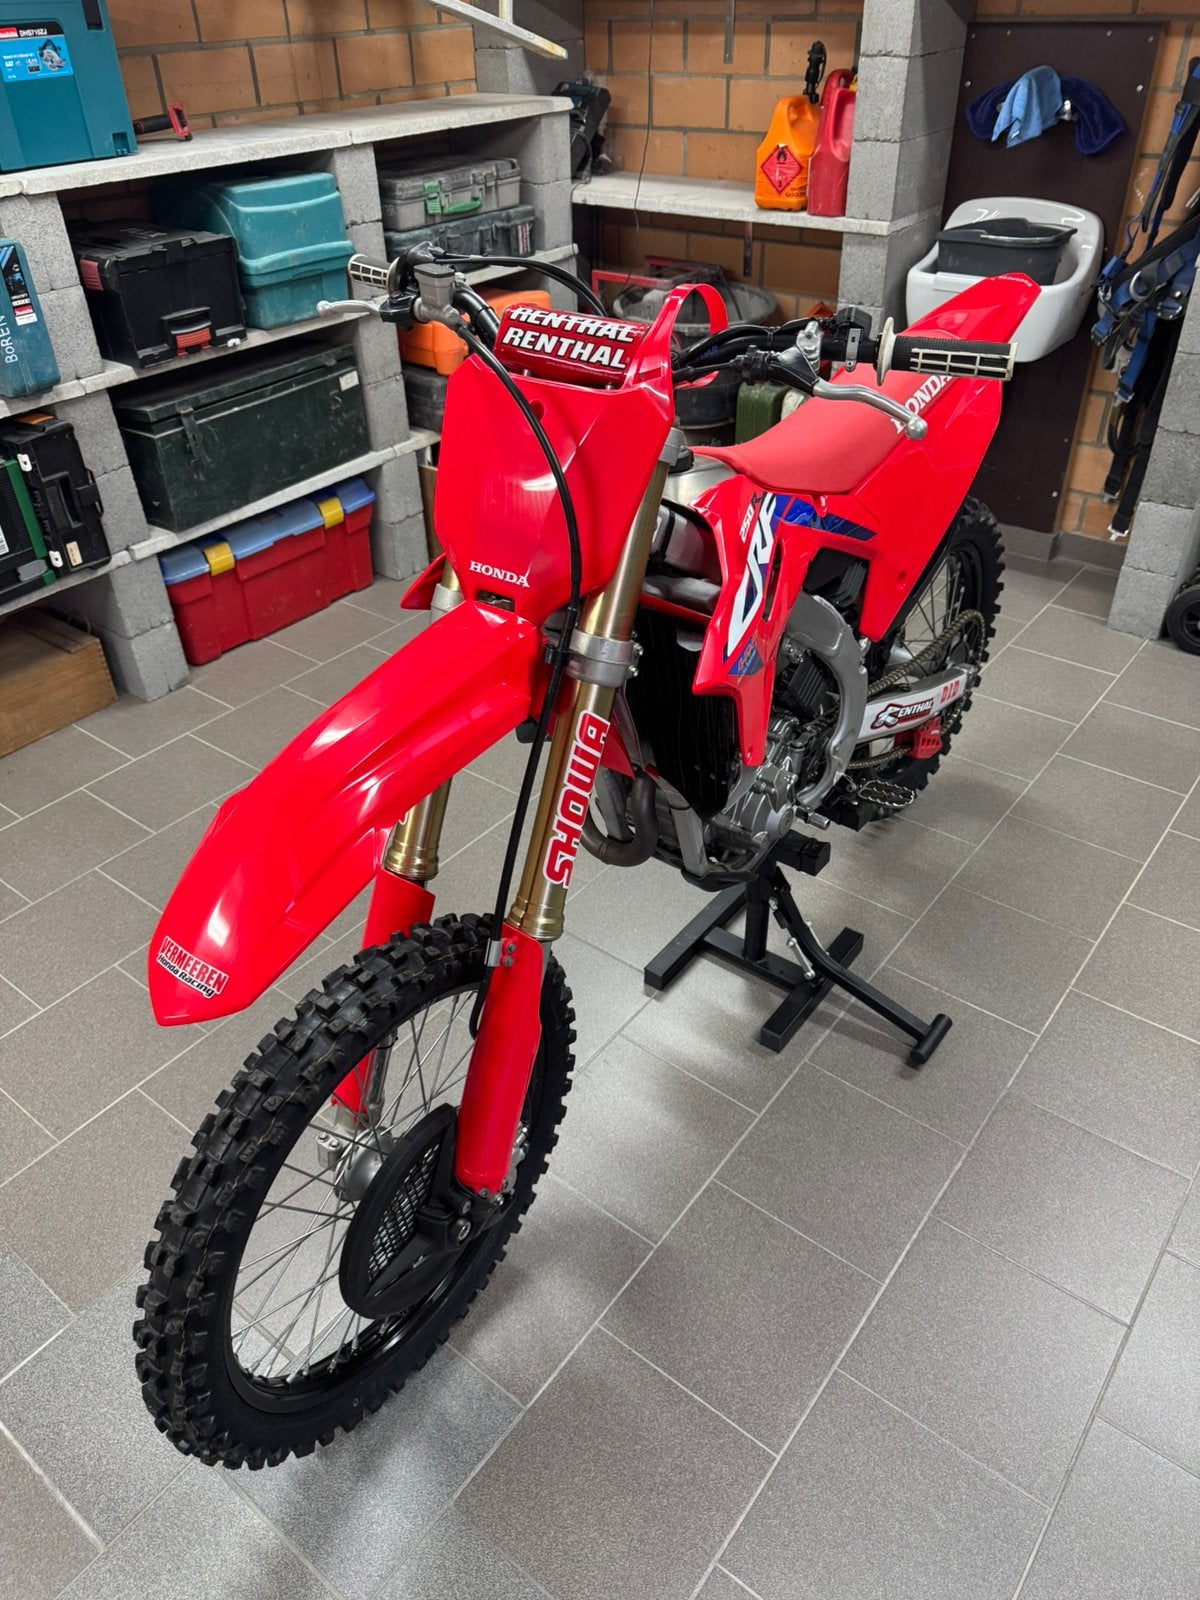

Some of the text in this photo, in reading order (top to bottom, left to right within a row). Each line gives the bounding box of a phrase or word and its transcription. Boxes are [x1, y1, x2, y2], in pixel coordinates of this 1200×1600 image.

[510, 307, 636, 343] RENTHAL
[502, 327, 627, 369] RENTHAL
[469, 560, 530, 588] HONDA
[727, 492, 776, 657] CRF
[940, 680, 960, 704] DID
[543, 710, 610, 889] SHOWA
[157, 954, 216, 998] Honda Racing
[160, 937, 228, 993] VERMEEREN
